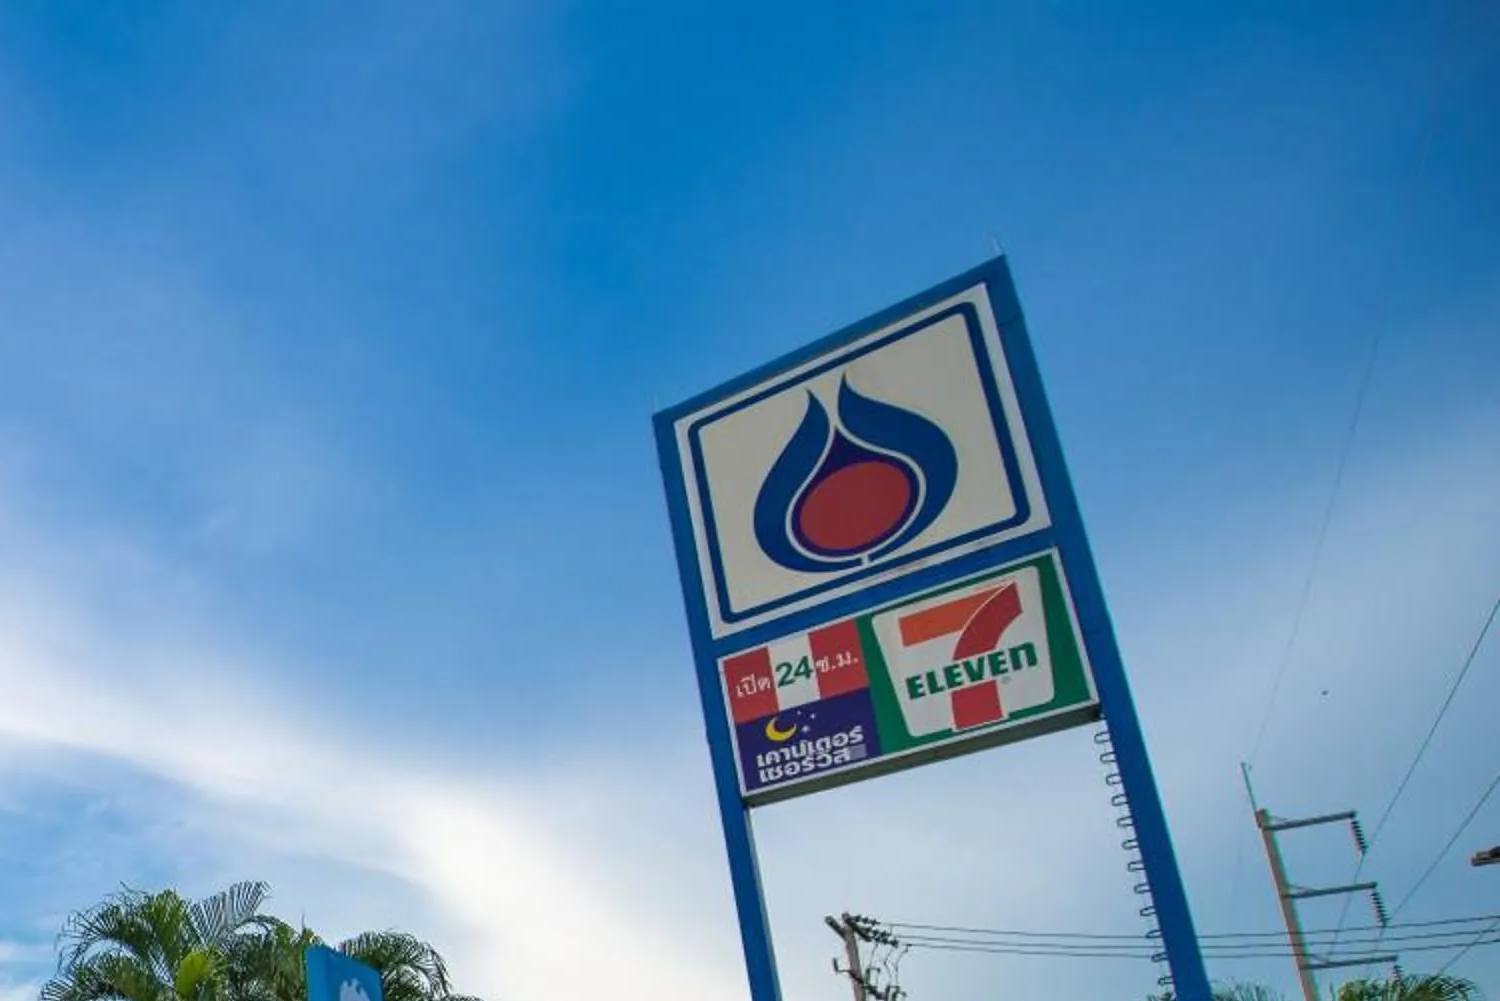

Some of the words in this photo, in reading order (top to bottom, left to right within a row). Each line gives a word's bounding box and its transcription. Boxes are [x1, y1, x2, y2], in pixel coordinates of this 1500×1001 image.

[735, 673, 772, 698] เปิด
[775, 655, 813, 688] 24
[898, 580, 1023, 730] 7
